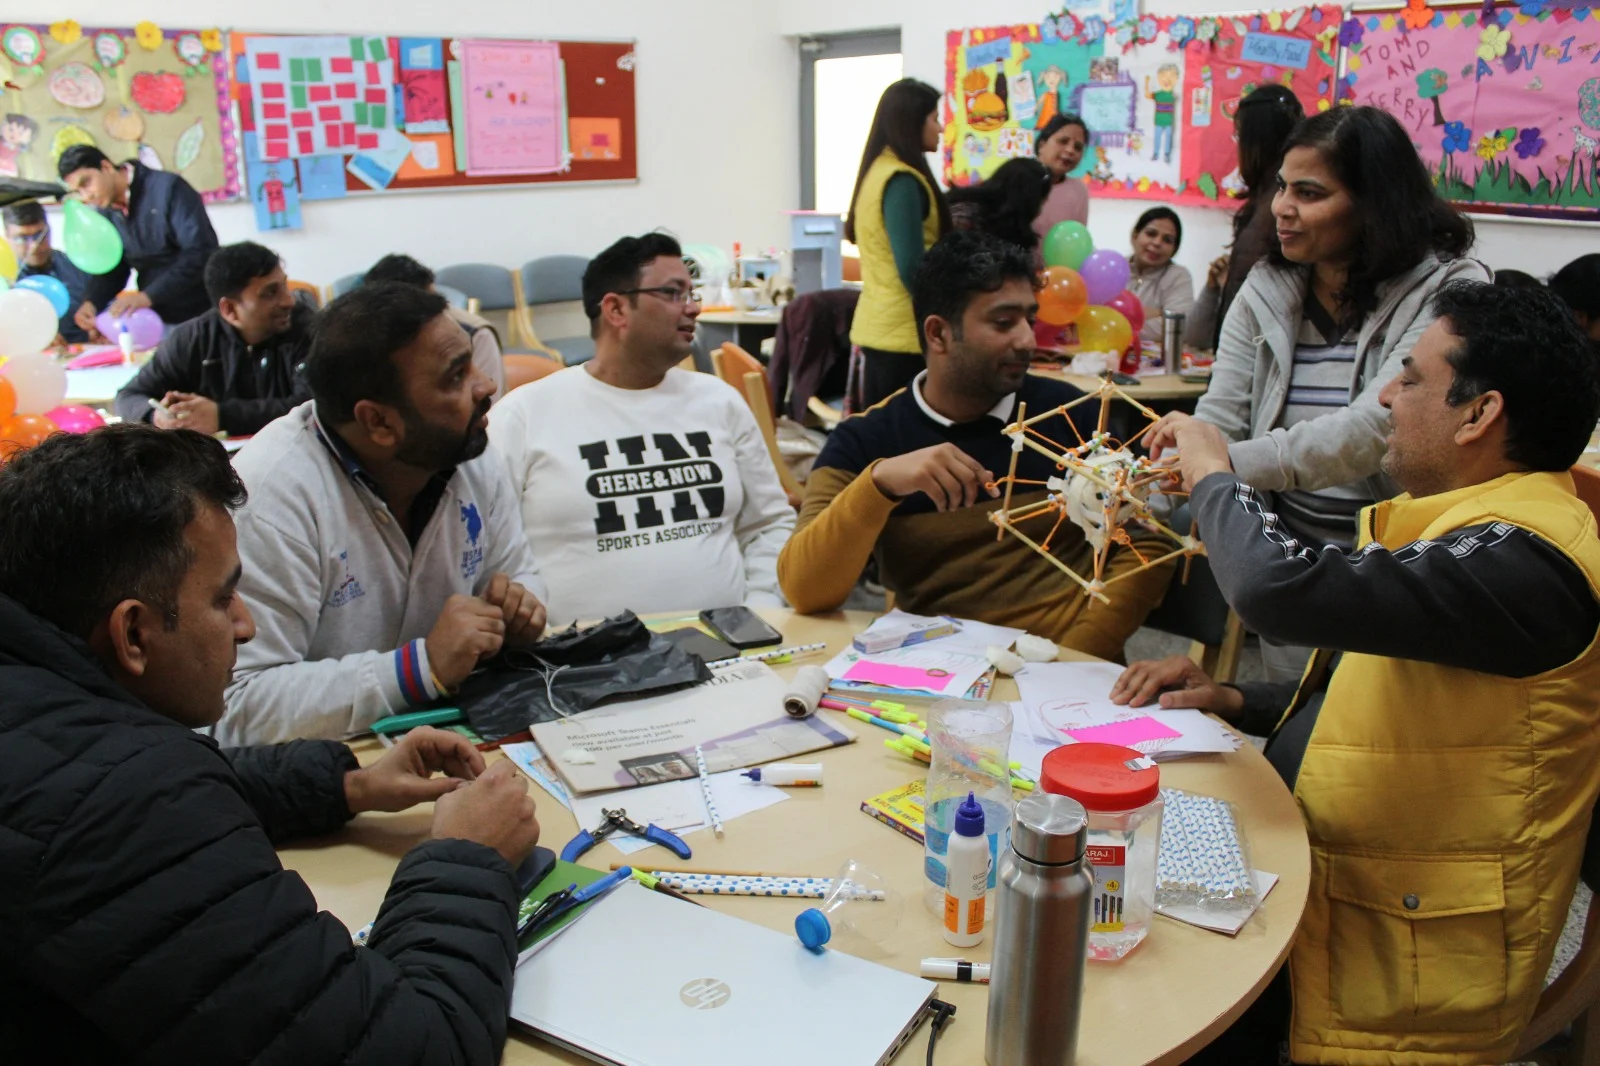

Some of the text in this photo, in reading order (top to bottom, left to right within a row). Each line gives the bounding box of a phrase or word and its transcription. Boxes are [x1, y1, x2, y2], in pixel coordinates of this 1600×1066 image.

[1359, 33, 1412, 65] TOM
[1386, 39, 1431, 81] AND
[596, 532, 652, 553] SPORTS
[566, 718, 696, 741] Microsoft Teams Essentials
[571, 739, 595, 748] now
[596, 734, 641, 746] available
[653, 728, 673, 740] just
[604, 741, 623, 752] per
